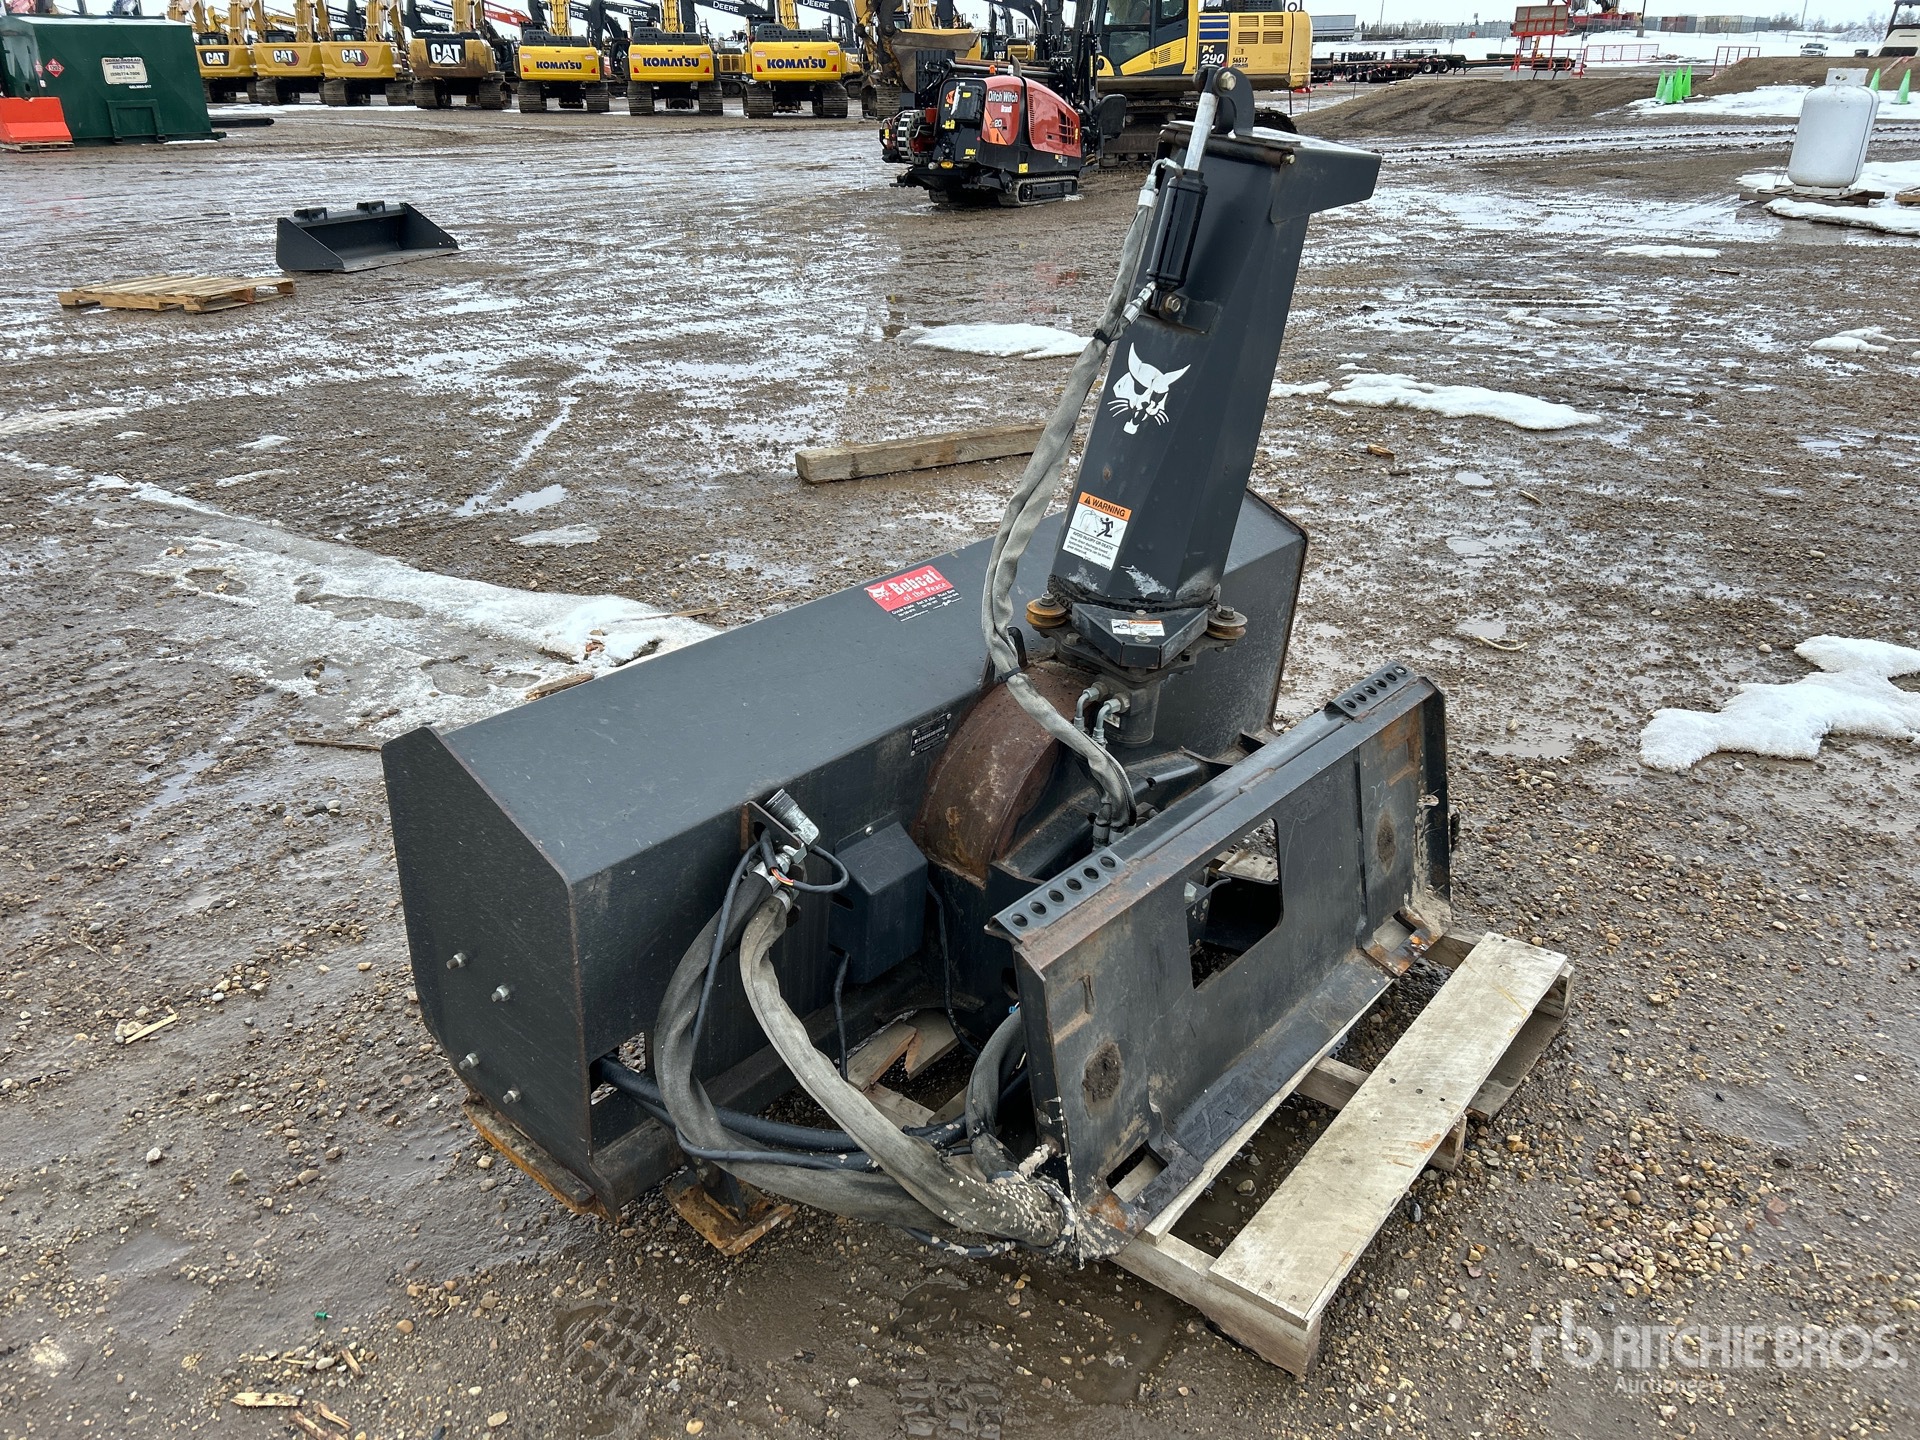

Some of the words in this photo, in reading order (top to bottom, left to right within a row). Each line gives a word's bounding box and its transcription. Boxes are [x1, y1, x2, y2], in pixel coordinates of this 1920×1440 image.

[622, 7, 648, 18] DEERE
[712, 1, 739, 13] DEERE
[329, 15, 346, 23] EERE
[435, 10, 452, 18] DEER
[571, 11, 584, 19] ERE
[430, 43, 462, 64] CAT
[994, 51, 1006, 59] CAT
[1201, 45, 1215, 54] PC
[205, 52, 225, 65] CAT
[273, 50, 293, 62] CAT
[341, 50, 362, 62] CAT
[642, 55, 700, 68] KOMATSU
[1200, 53, 1225, 64] 290
[536, 60, 582, 70] KOMATSU
[767, 56, 827, 69] KOMATSU
[988, 90, 1002, 101] Ditch
[1003, 91, 1018, 102] Witch
[1092, 498, 1126, 517] WARNING
[888, 569, 941, 595] Bobcat
[911, 590, 926, 598] the
[924, 582, 948, 593] Peace
